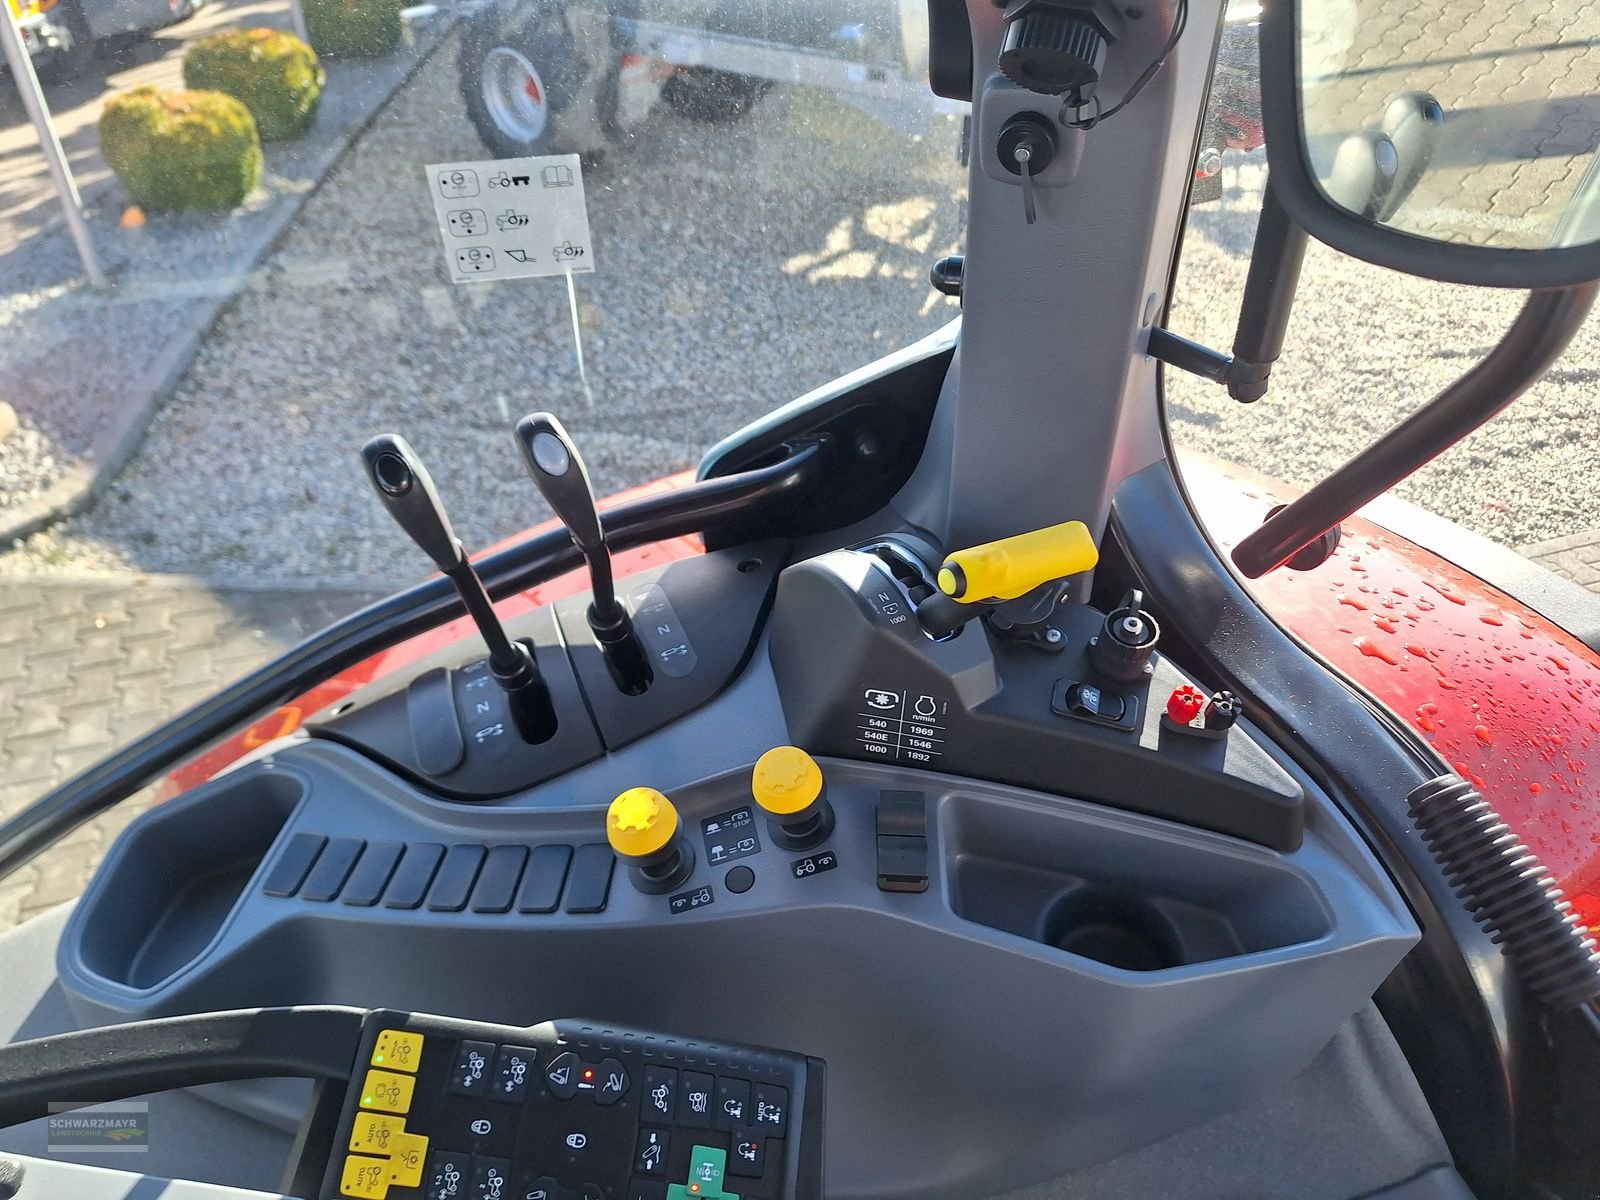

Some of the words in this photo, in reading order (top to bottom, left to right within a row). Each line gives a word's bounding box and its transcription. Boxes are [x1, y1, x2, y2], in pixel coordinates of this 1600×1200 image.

[889, 614, 907, 625] 1000
[869, 719, 887, 728] 540
[912, 714, 936, 723] n/min
[864, 731, 888, 741] 540E
[910, 726, 934, 736] 1969
[864, 744, 887, 754] 1000
[908, 739, 932, 749] 1546
[907, 751, 930, 762] 1892
[732, 818, 751, 829] STOP
[756, 1101, 765, 1122] AUTO
[367, 1123, 376, 1144] AUTO
[356, 1167, 366, 1187] AUTO
